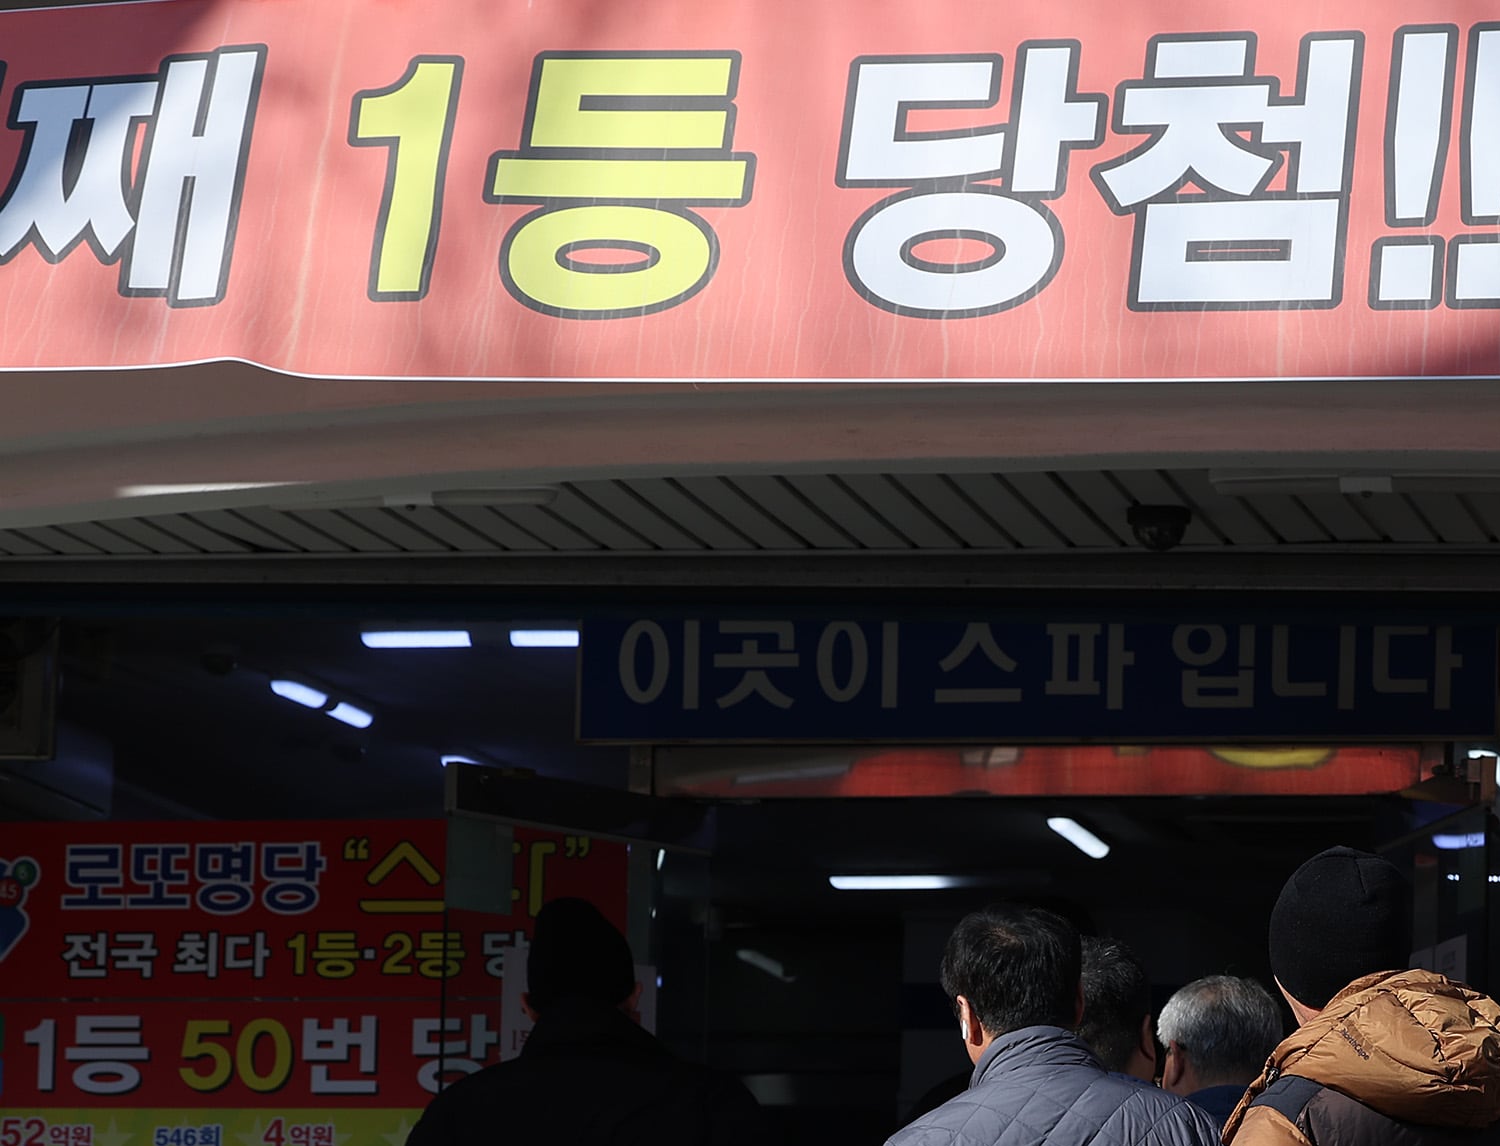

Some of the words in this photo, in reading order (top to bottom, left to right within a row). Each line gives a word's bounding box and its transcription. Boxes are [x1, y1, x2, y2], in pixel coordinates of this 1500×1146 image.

[0, 44, 267, 307] 째
[347, 50, 757, 320] 1등
[618, 620, 898, 708] 이곳이
[934, 621, 1134, 709] 스파
[1170, 624, 1462, 709] 입니다
[60, 842, 326, 914] 로또명당
[61, 932, 158, 977] 전국
[173, 932, 270, 977] 최다
[24, 1014, 149, 1095] 1등
